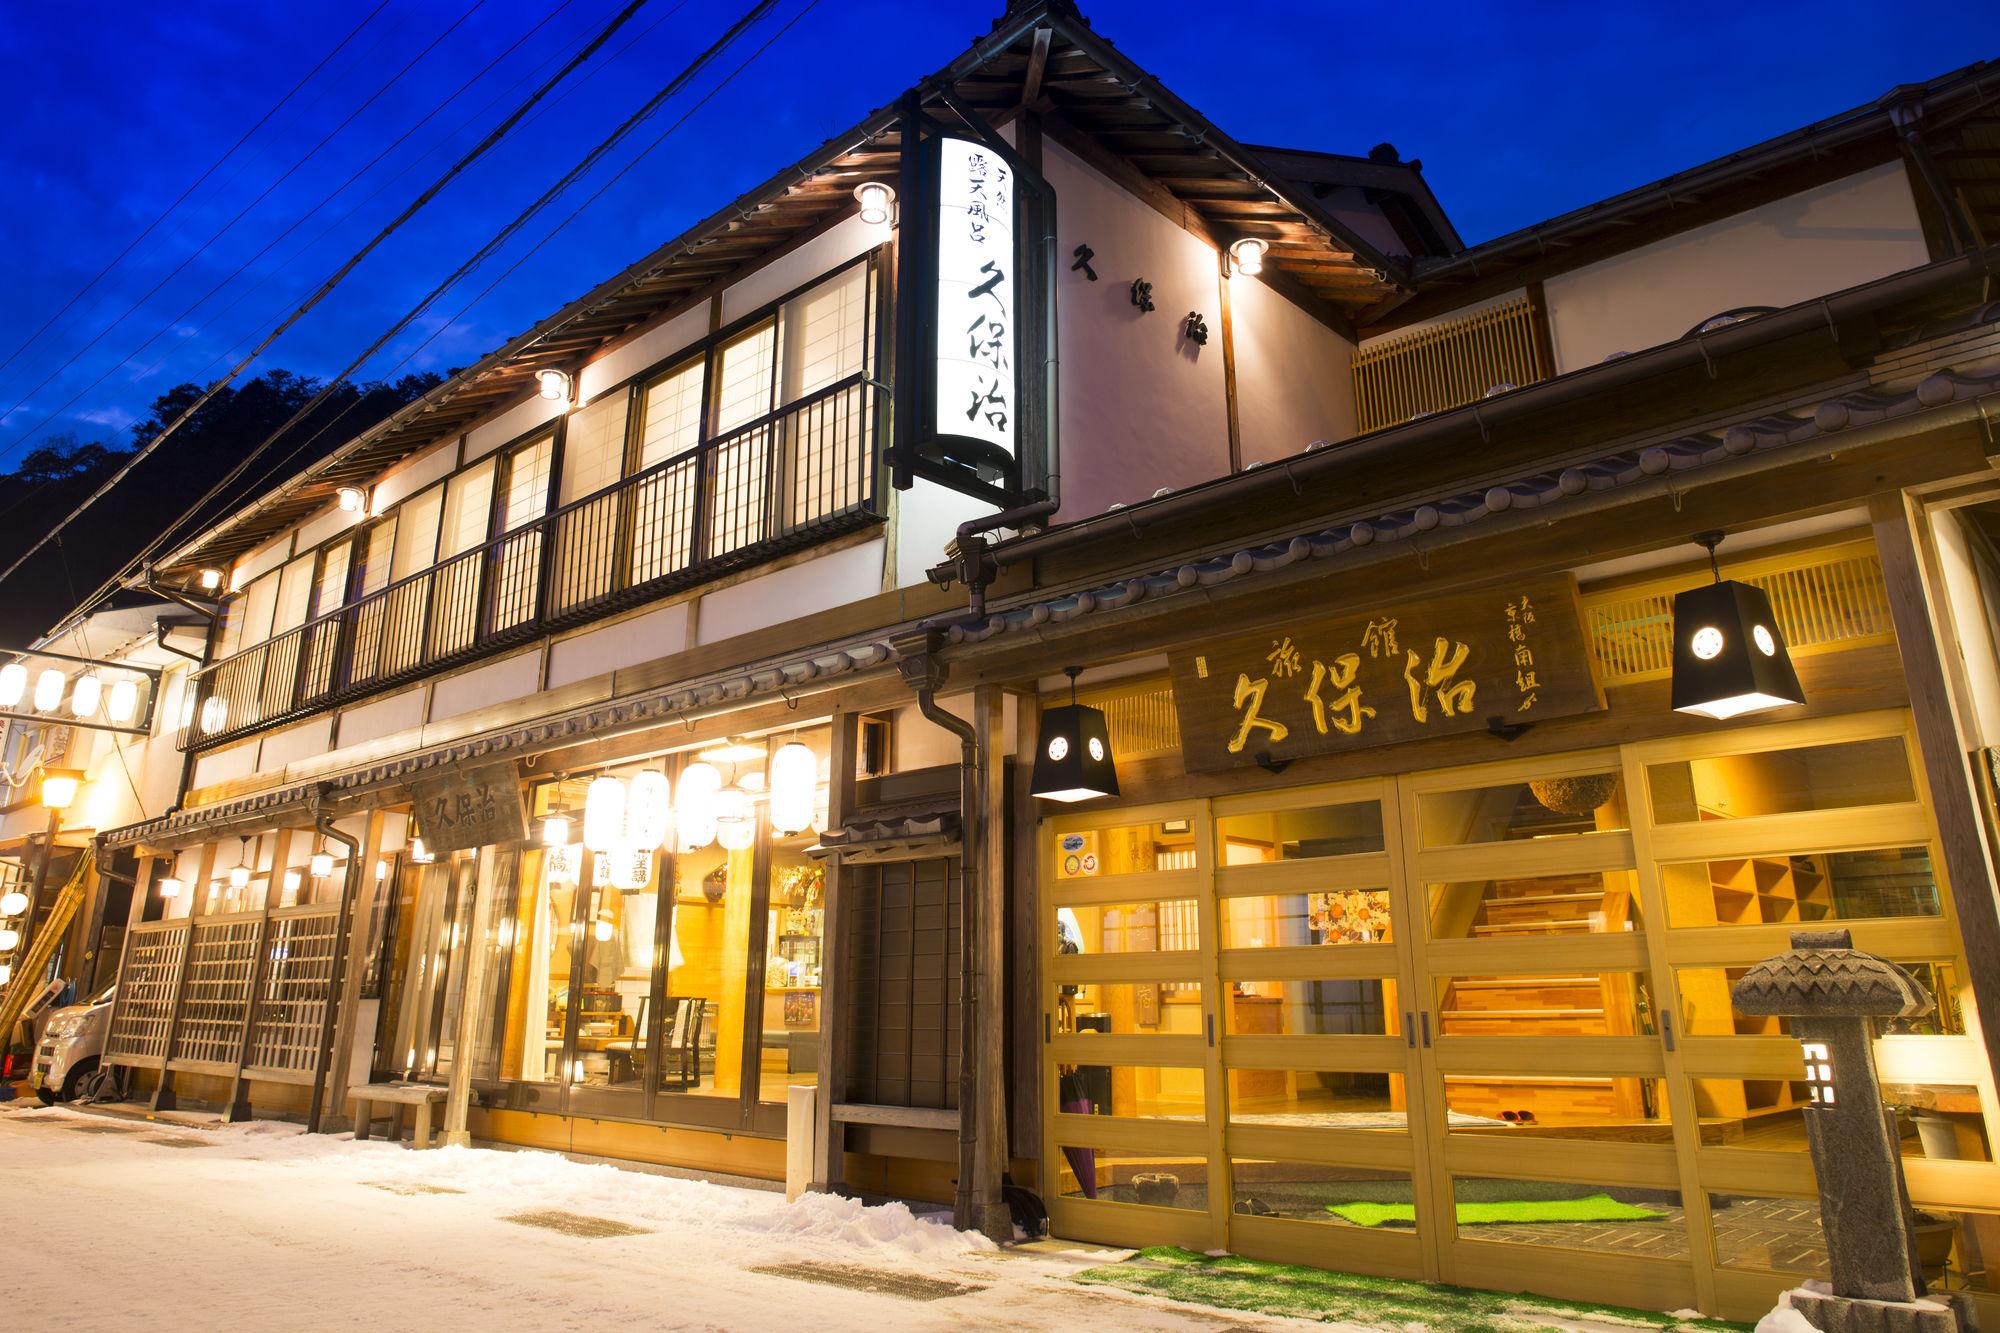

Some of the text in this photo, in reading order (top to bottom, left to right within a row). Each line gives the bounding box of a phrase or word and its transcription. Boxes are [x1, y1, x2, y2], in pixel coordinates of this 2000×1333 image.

[967, 153, 990, 244] 露天風呂
[1071, 243, 1208, 345] 久保治
[966, 260, 1009, 432] 久保治
[1228, 636, 1477, 753] 久保治
[435, 784, 496, 829] 久保治
